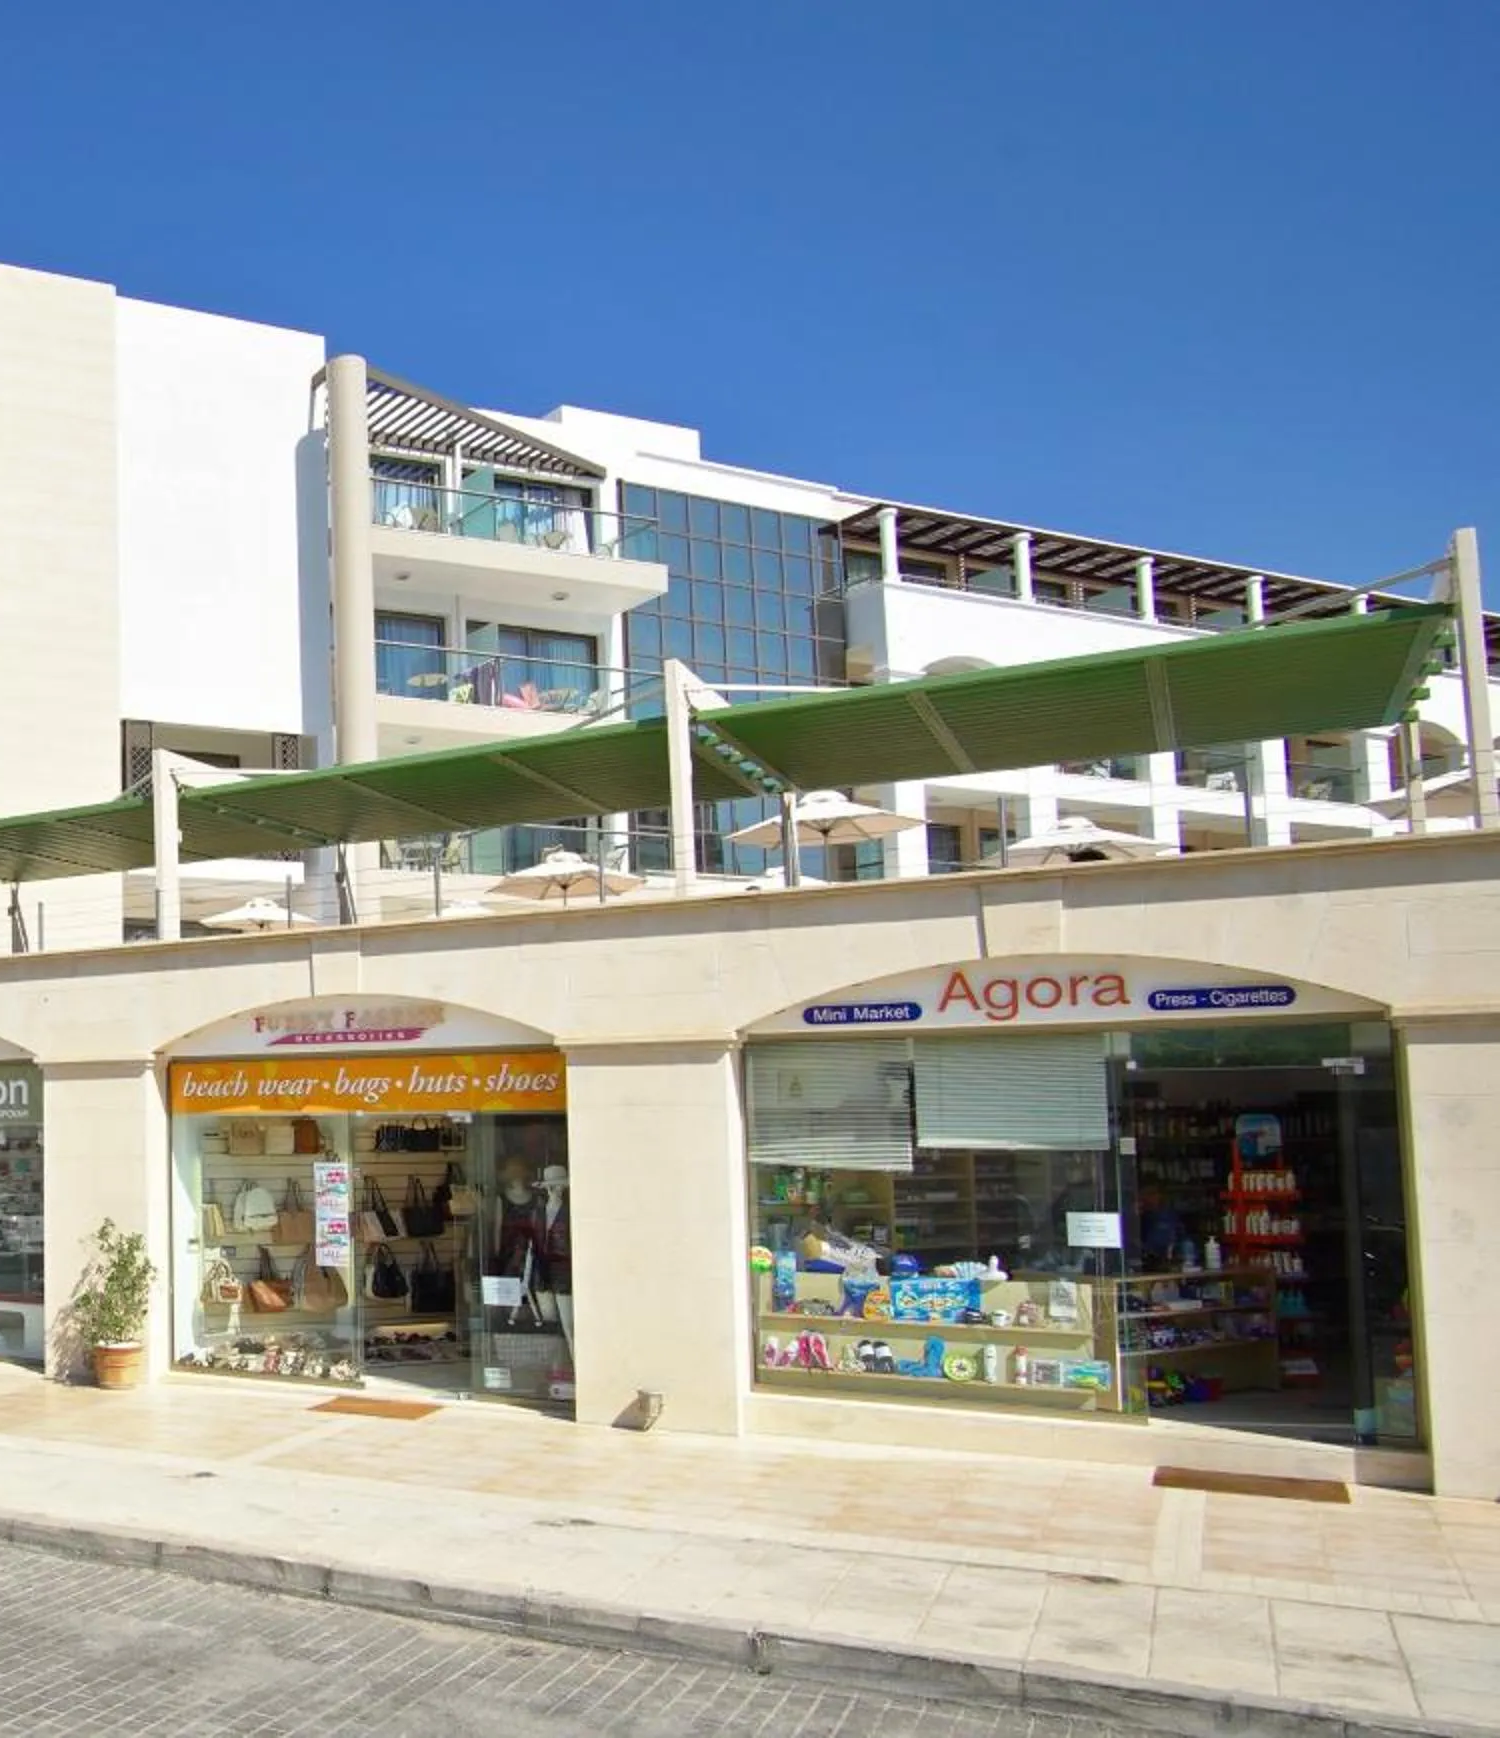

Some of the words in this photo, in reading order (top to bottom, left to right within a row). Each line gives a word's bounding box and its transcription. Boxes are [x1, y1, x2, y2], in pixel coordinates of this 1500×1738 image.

[938, 971, 1130, 1021] Agora
[1155, 993, 1197, 1006] Press
[1209, 990, 1287, 1007] Cigarettes
[813, 1007, 847, 1022] Mini
[853, 1005, 911, 1020] Market
[183, 1071, 249, 1097] beach
[257, 1078, 319, 1096] wear
[335, 1067, 390, 1103] bags
[484, 1063, 560, 1092] shoes
